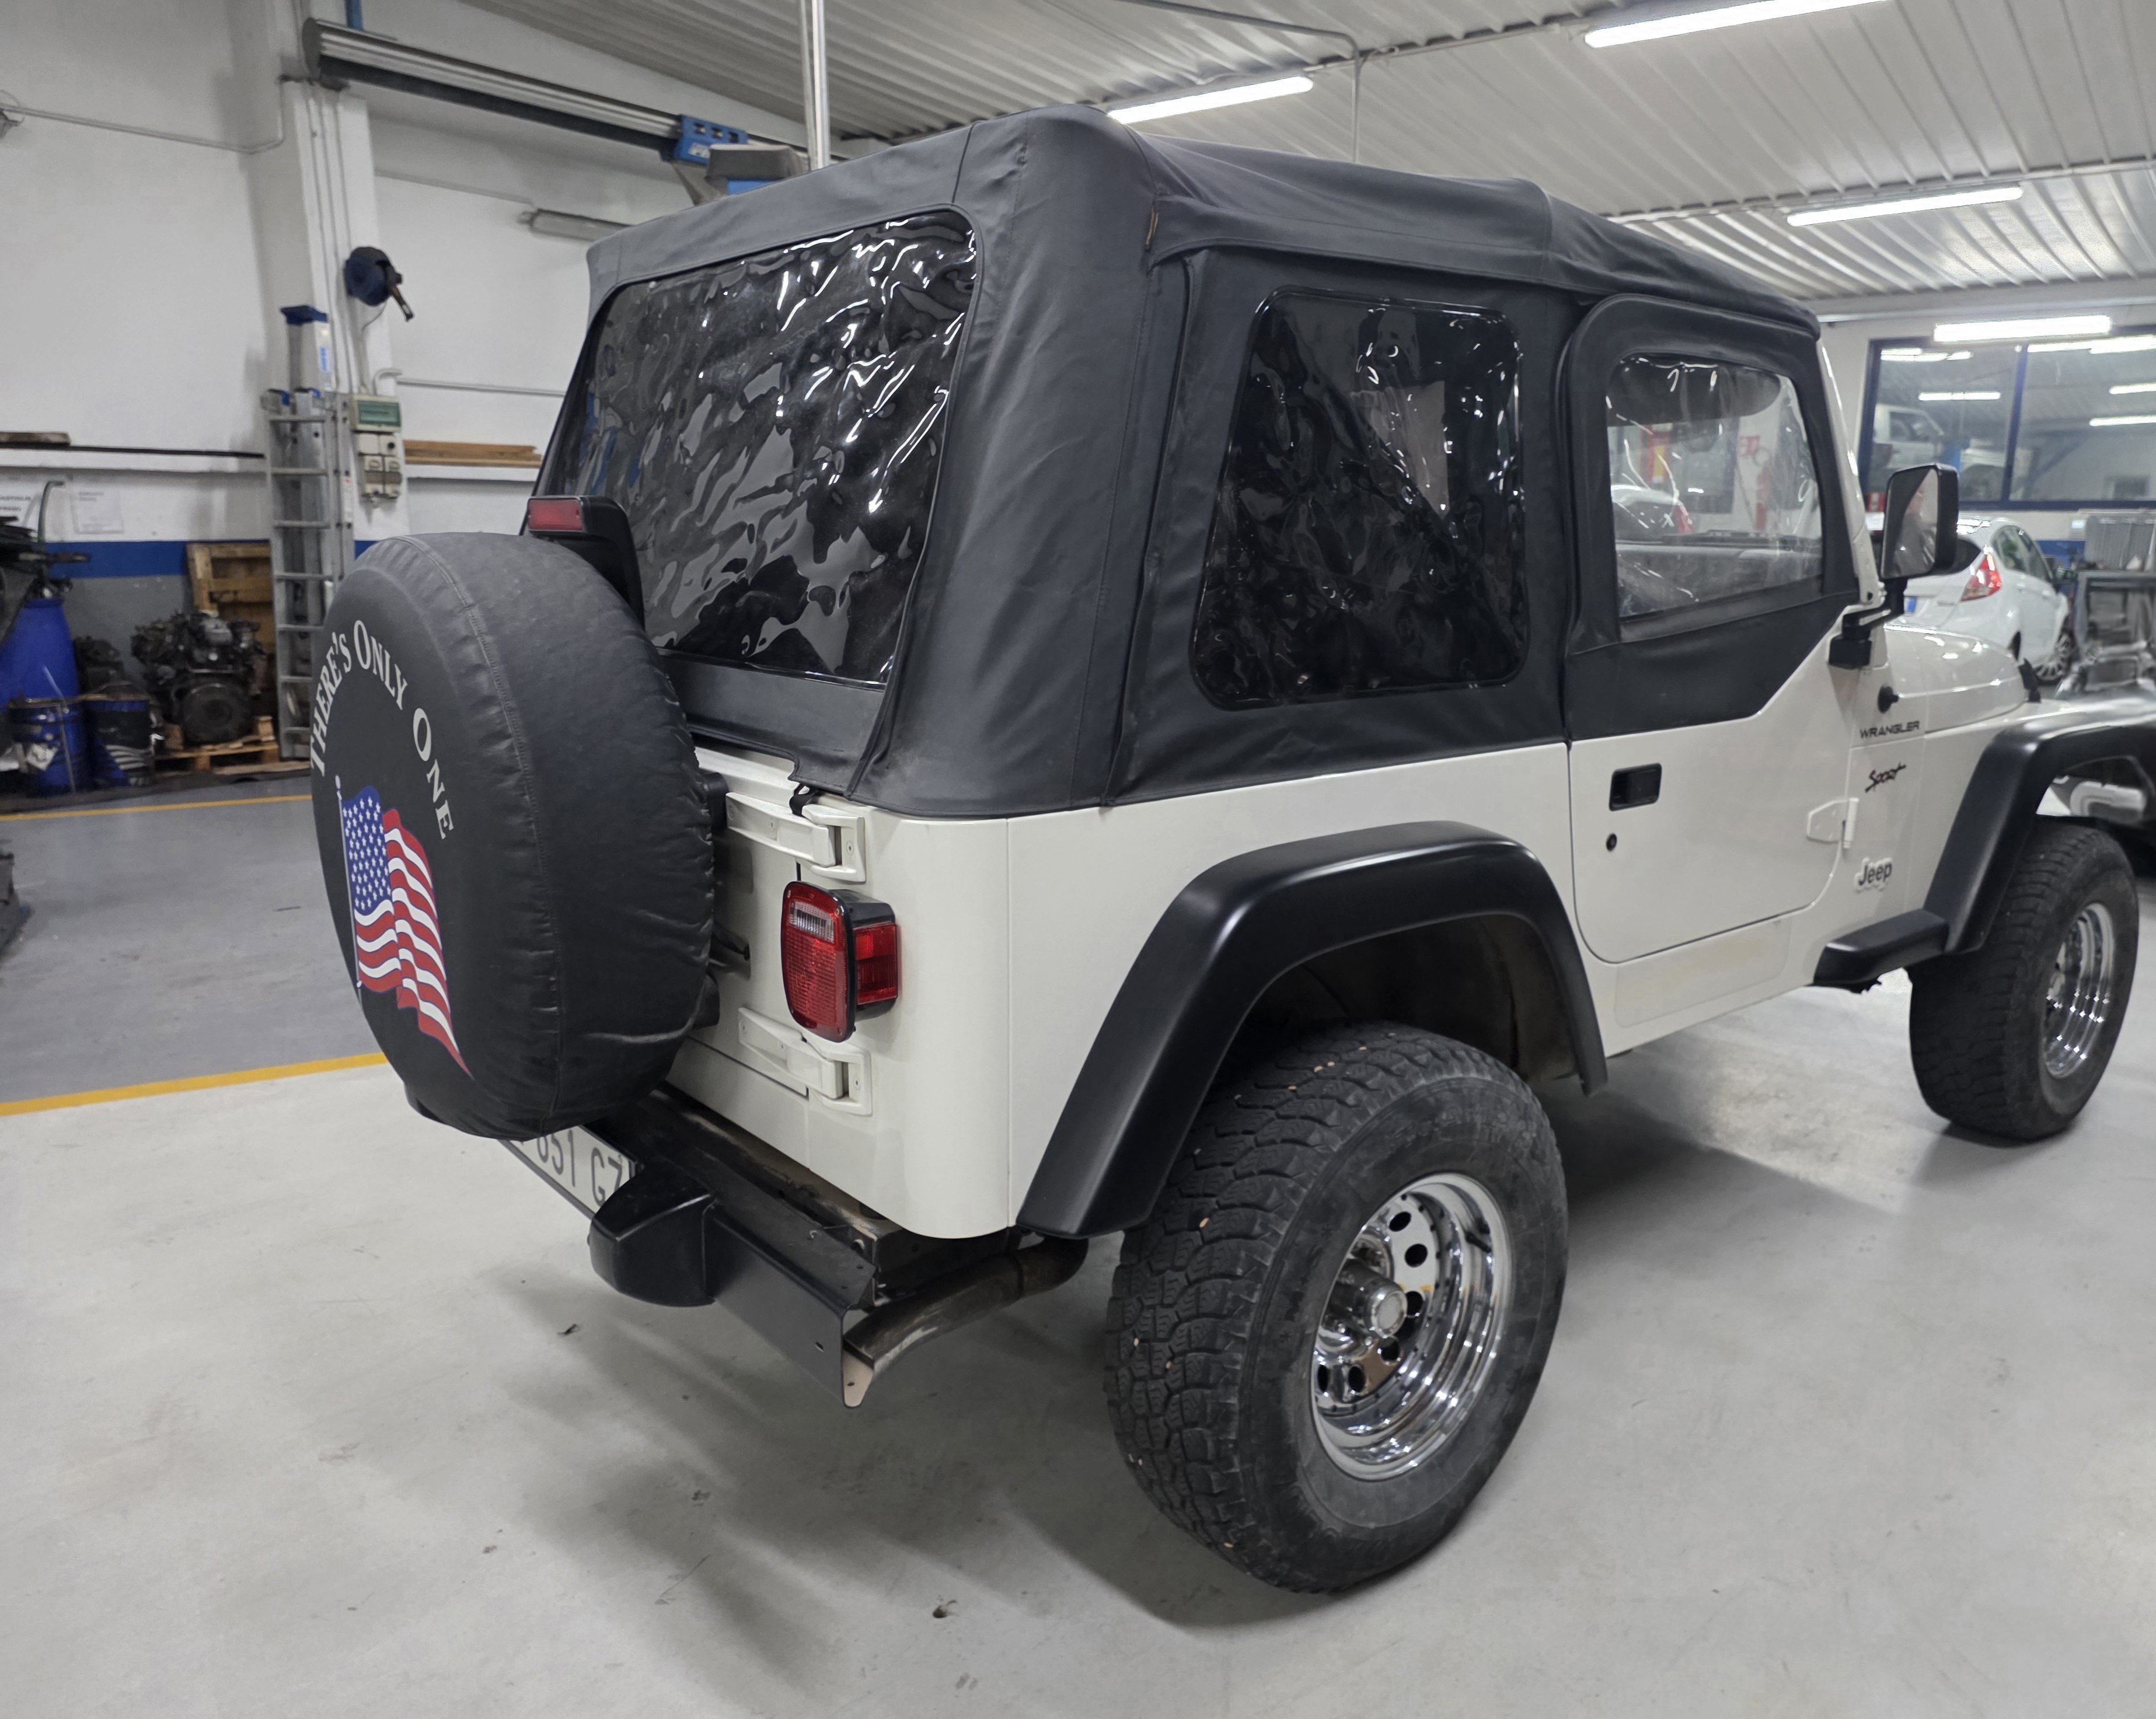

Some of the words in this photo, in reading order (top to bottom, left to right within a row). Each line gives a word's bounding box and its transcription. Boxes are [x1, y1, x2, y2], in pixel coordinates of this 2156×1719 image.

[310, 631, 352, 777] THERE'S
[354, 620, 408, 711] ONLY
[413, 708, 454, 839] ONE
[1860, 721, 1920, 738] WRANGLER
[1858, 862, 1892, 886] Jeep
